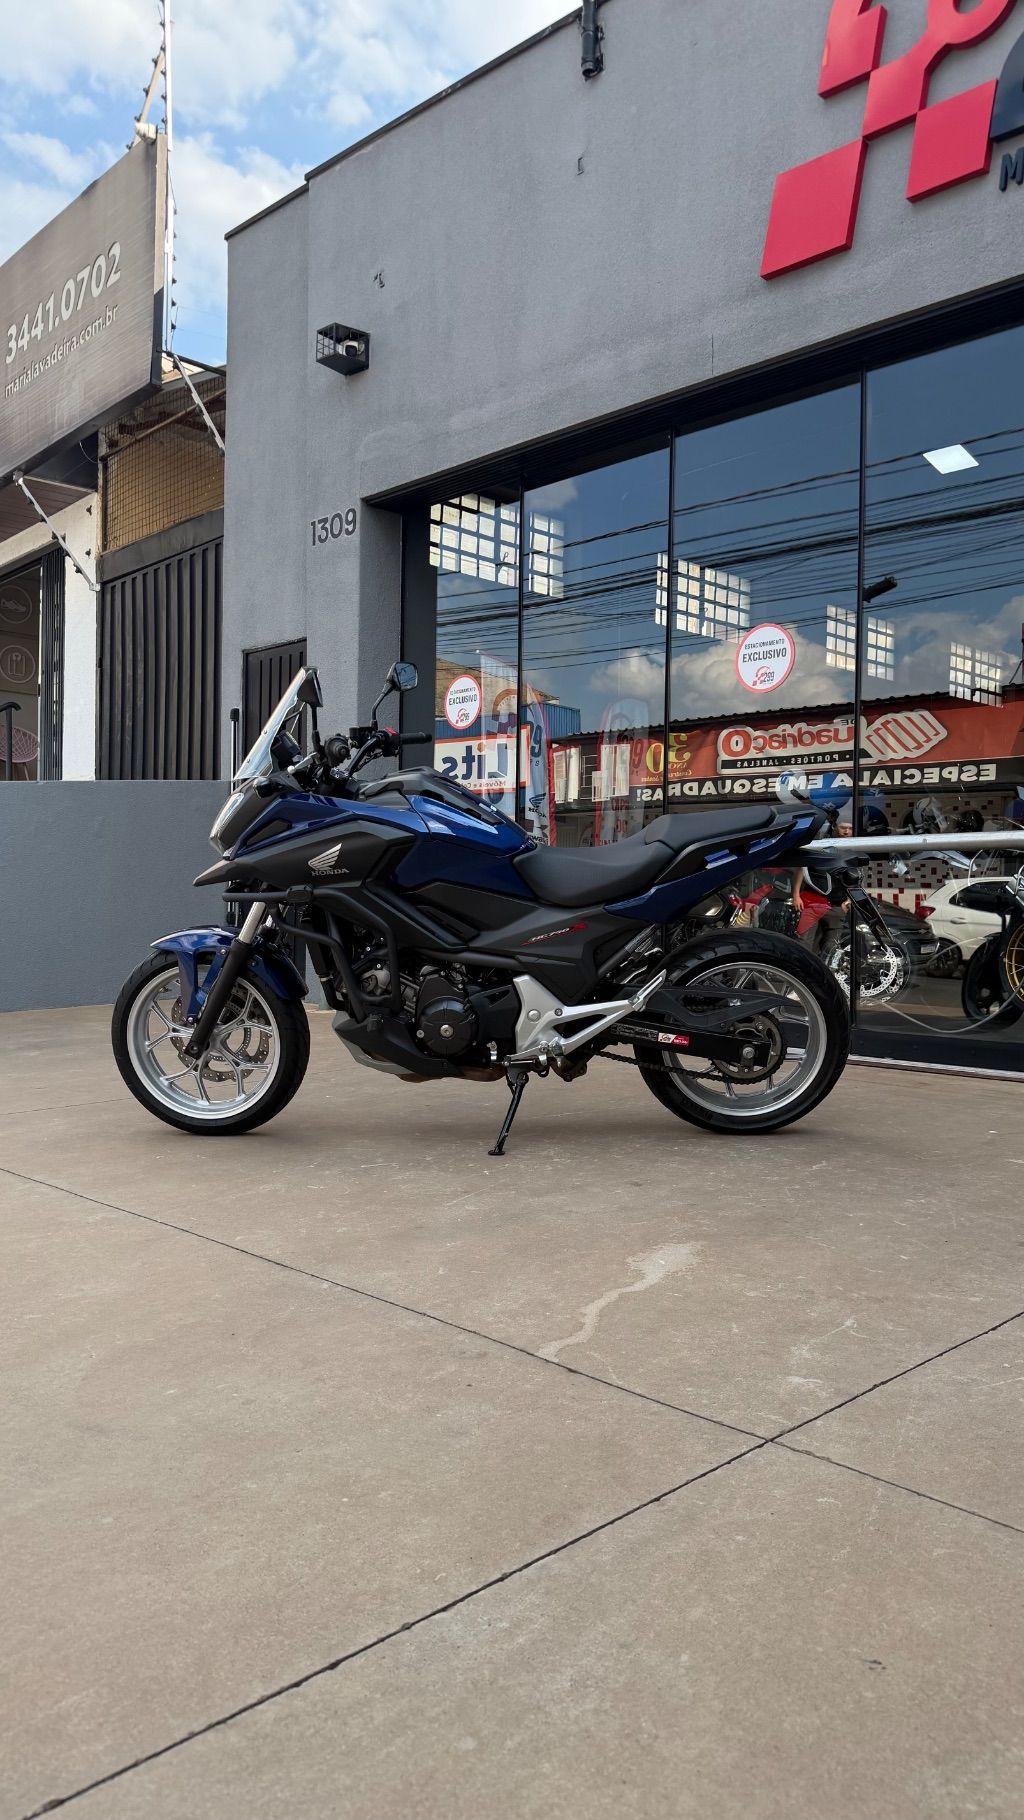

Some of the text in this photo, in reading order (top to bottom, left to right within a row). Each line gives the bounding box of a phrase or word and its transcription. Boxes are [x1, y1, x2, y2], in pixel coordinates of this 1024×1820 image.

[5, 241, 121, 364] 3441.0702
[5, 304, 118, 398] marialavadeira.com.br
[311, 508, 357, 546] 1309
[745, 638, 785, 649] ESTACIONAMENTO
[742, 647, 787, 663] EXCLUSIVO
[449, 694, 477, 705] EXCLUSIVO
[311, 868, 350, 877] HONDA
